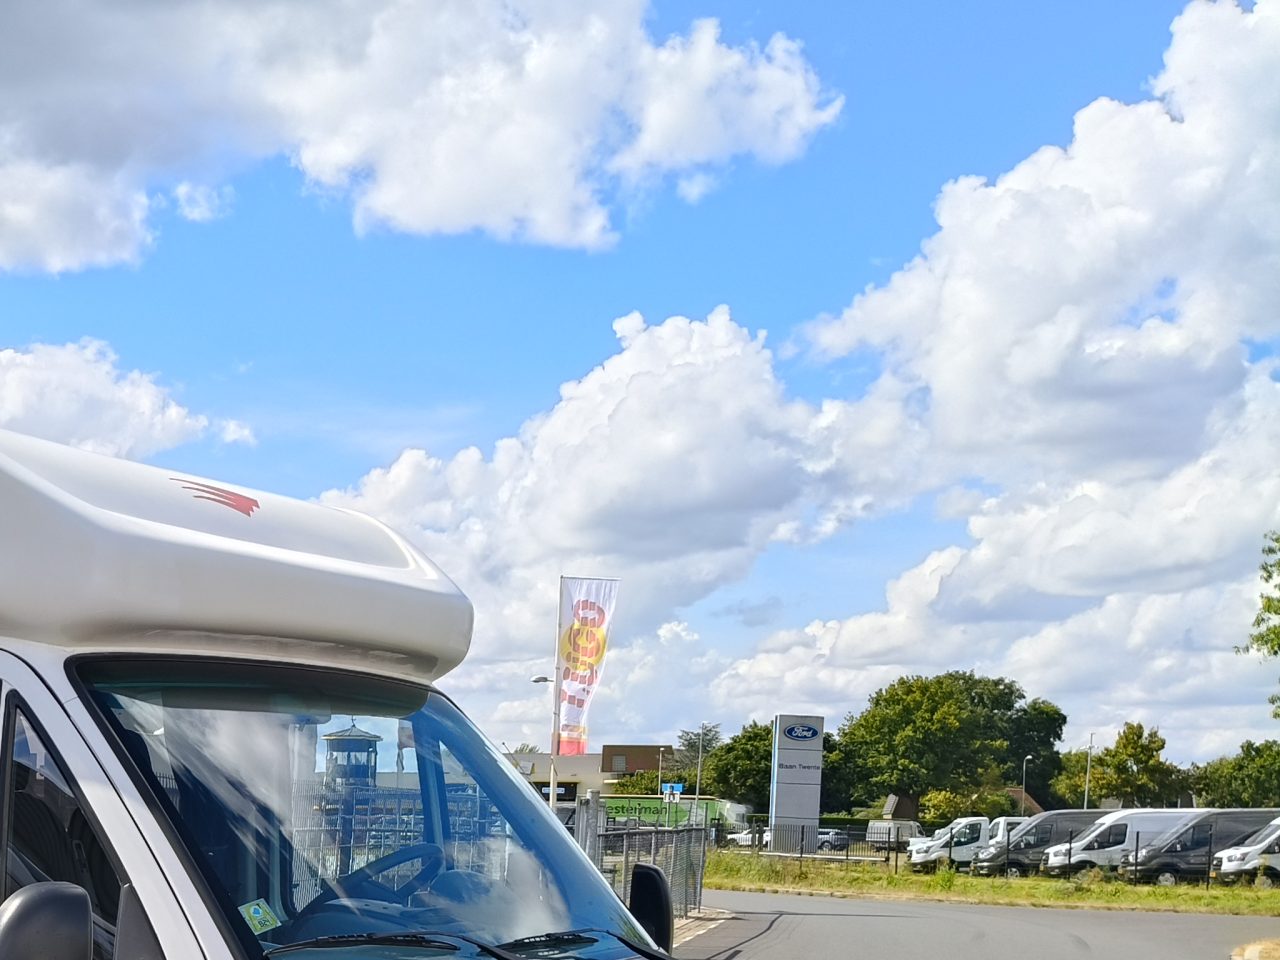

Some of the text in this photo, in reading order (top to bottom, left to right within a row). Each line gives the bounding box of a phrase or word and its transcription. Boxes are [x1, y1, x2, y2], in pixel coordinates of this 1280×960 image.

[792, 726, 813, 737] Ford
[798, 763, 821, 771] Twente
[605, 804, 668, 815] esterman
